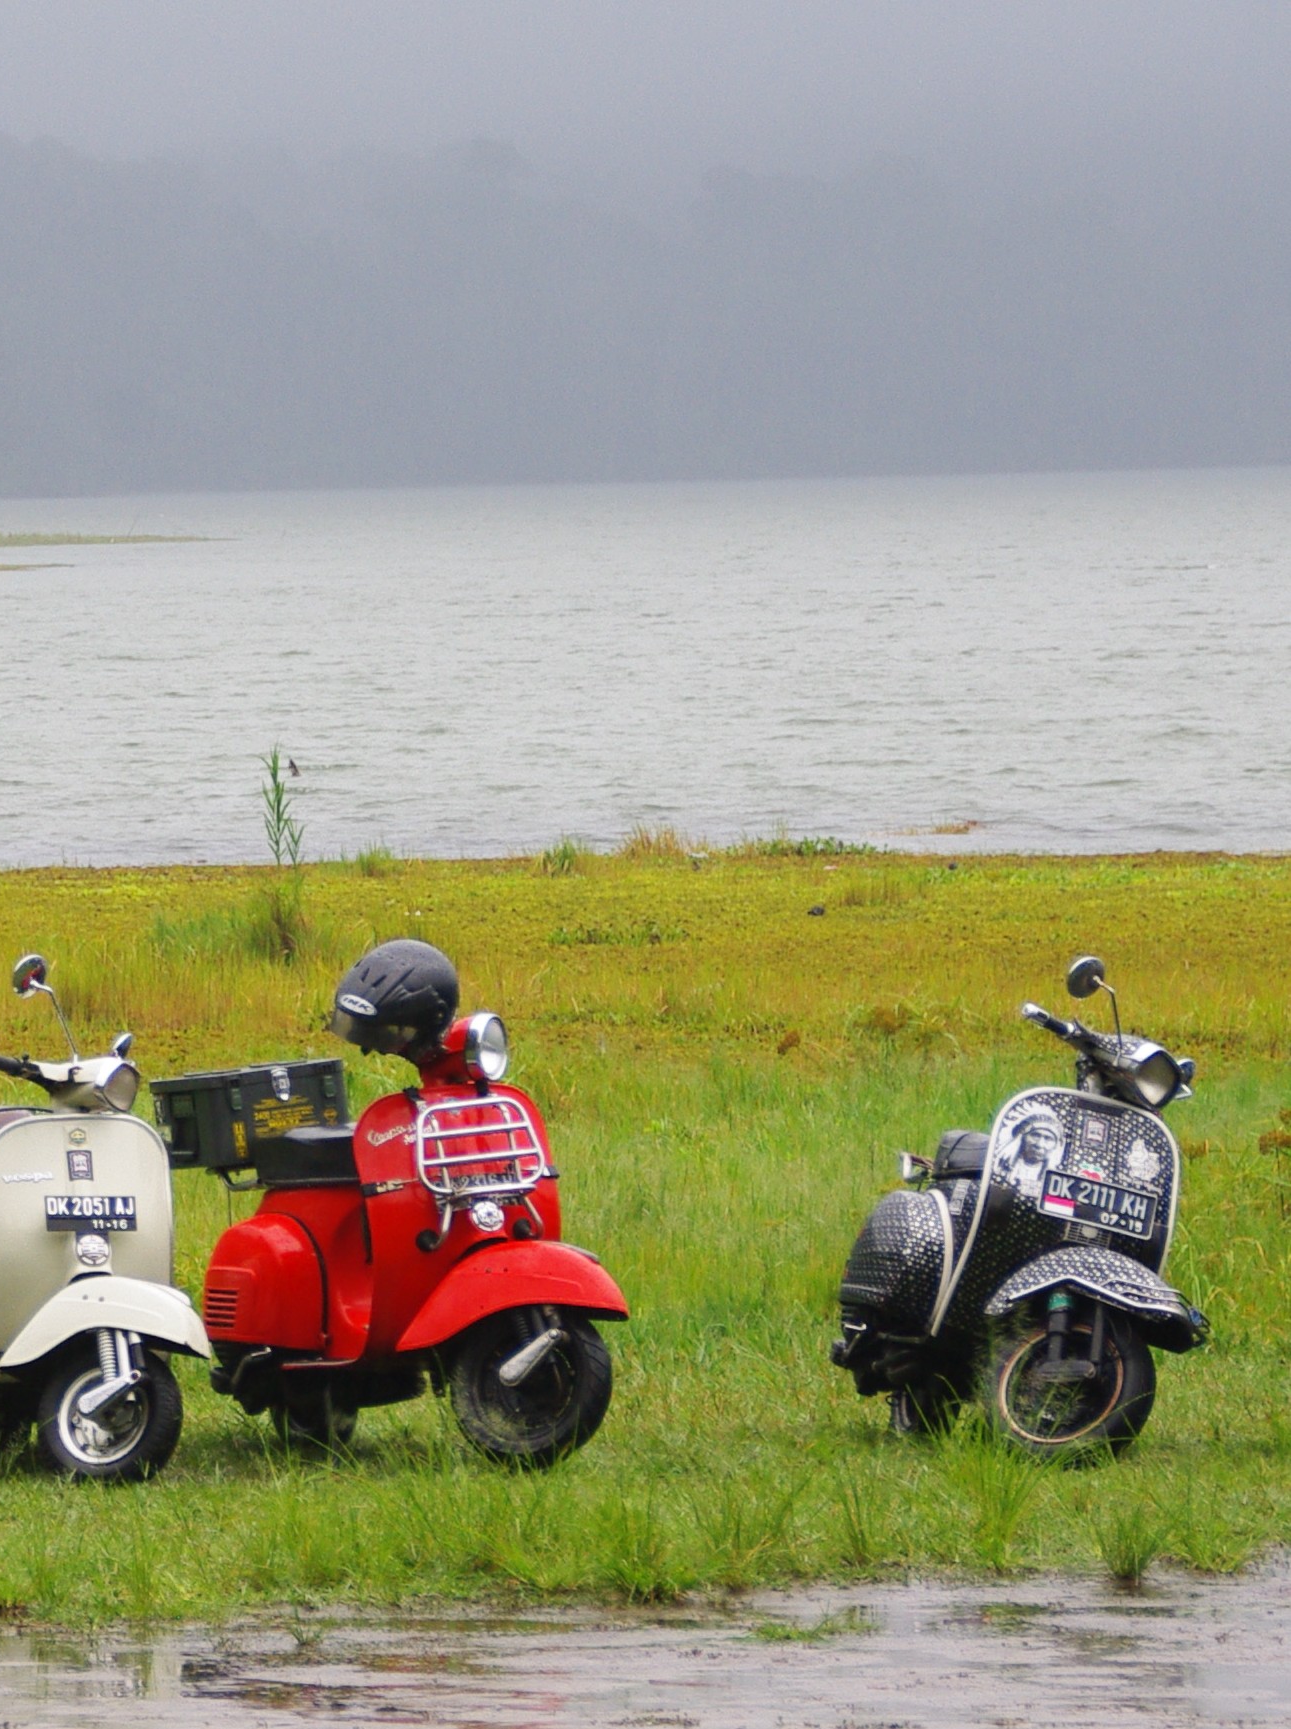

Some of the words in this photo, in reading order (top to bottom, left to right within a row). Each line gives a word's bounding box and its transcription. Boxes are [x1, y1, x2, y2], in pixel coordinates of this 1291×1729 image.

[46, 1197, 69, 1216] DK
[71, 1197, 110, 1217] 2051
[115, 1197, 134, 1216] AJ
[1047, 1175, 1075, 1200] DK
[1077, 1181, 1117, 1212] 2111
[1120, 1193, 1148, 1220] KH
